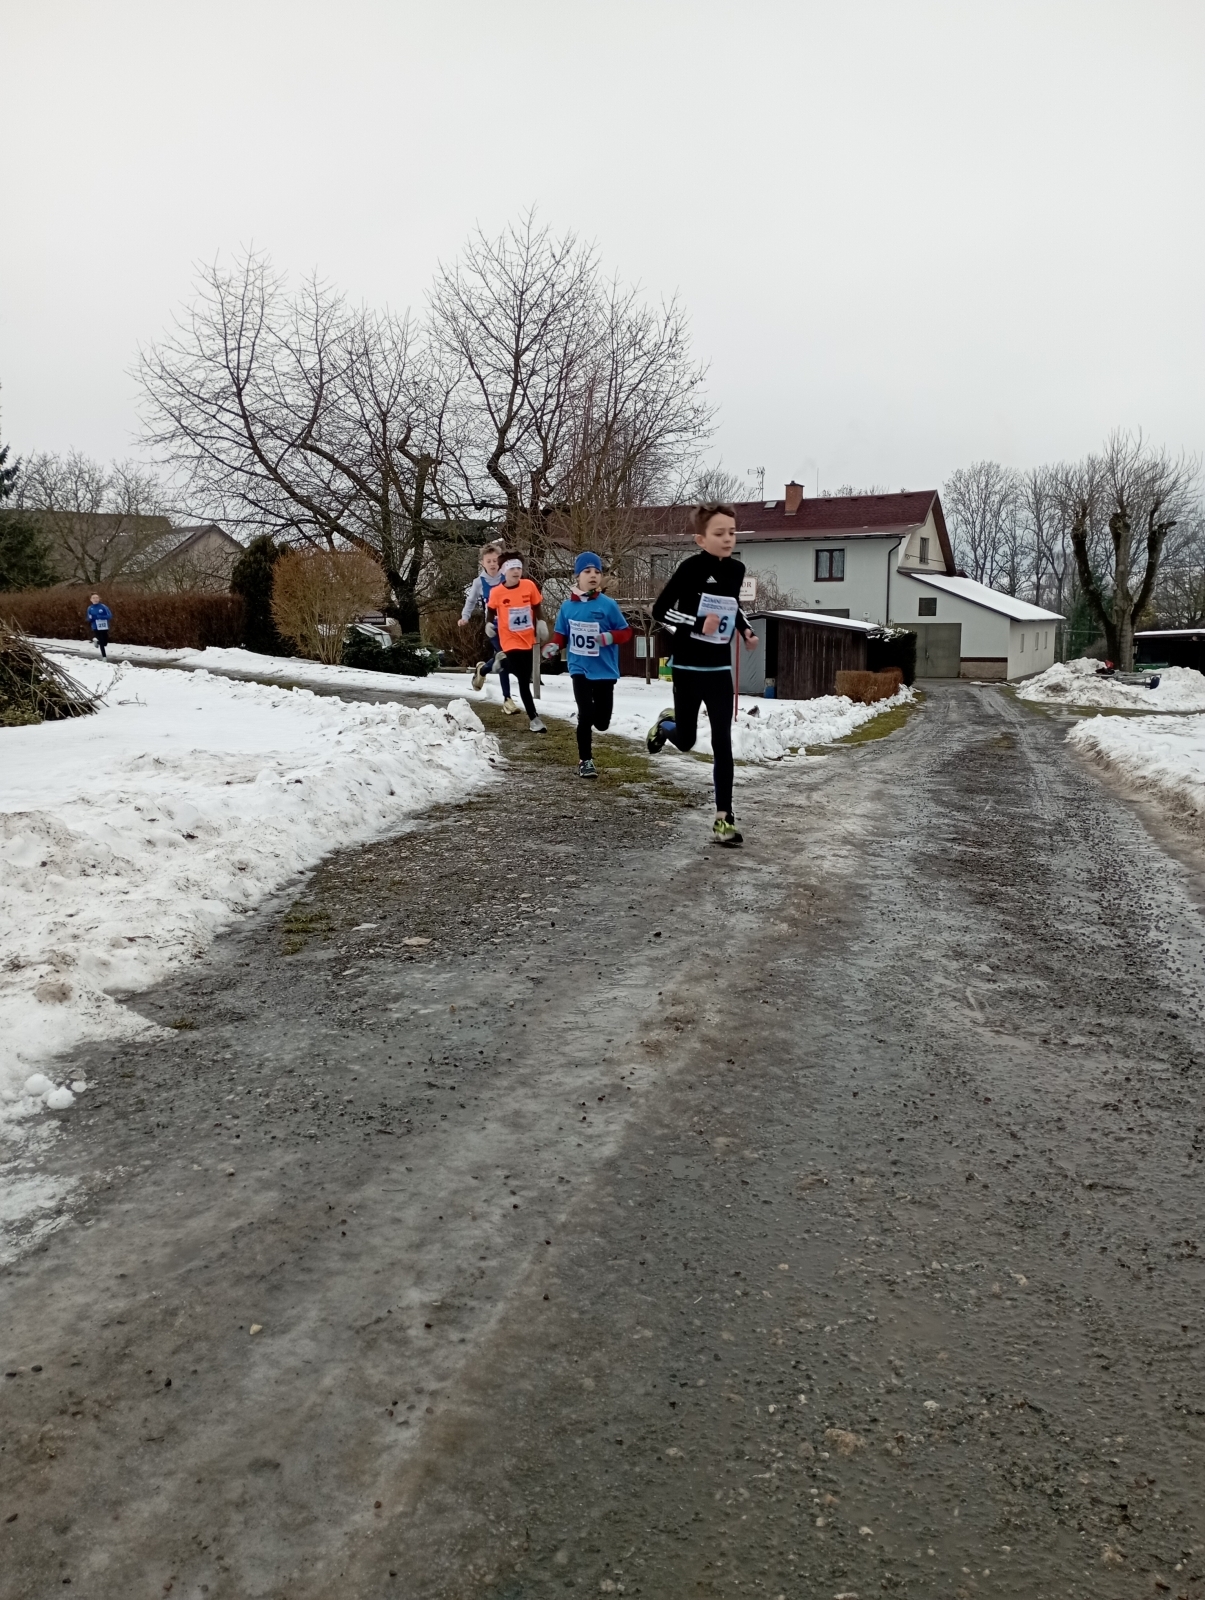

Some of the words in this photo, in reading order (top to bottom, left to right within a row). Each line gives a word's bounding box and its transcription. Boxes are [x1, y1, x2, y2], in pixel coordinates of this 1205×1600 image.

[513, 615, 528, 626] 44
[718, 615, 729, 634] 6
[571, 633, 596, 650] 105
